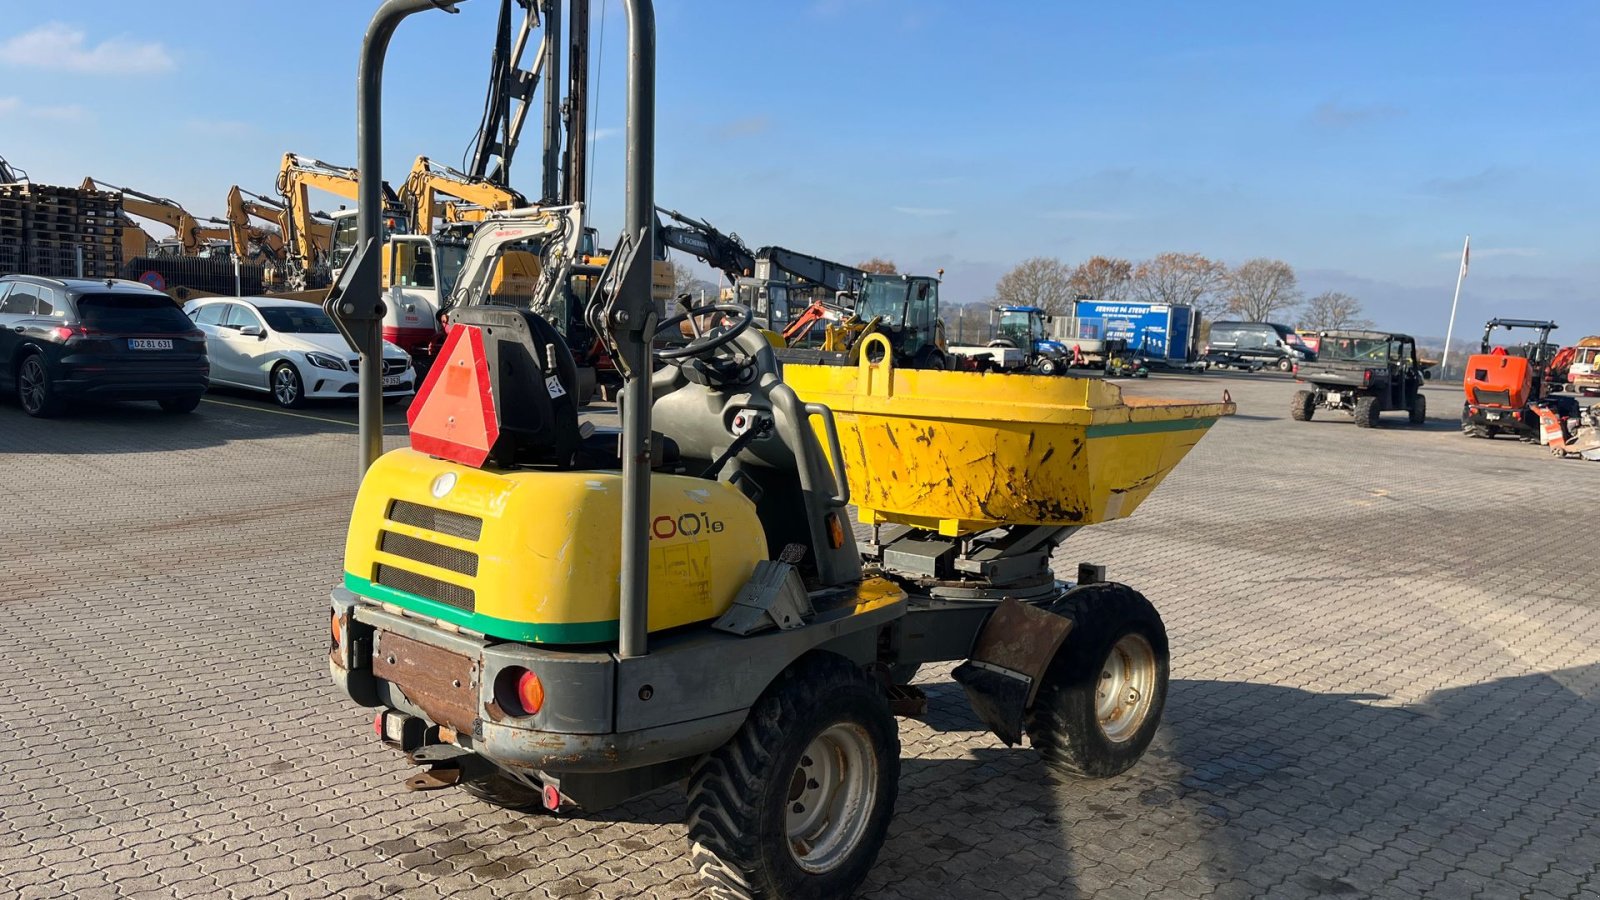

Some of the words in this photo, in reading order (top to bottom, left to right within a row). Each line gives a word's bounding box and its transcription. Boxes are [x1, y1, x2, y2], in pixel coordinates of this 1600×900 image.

[1120, 305, 1128, 313] PÅ
[134, 340, 145, 348] DZ
[146, 340, 156, 348] 81
[157, 340, 171, 348] 631
